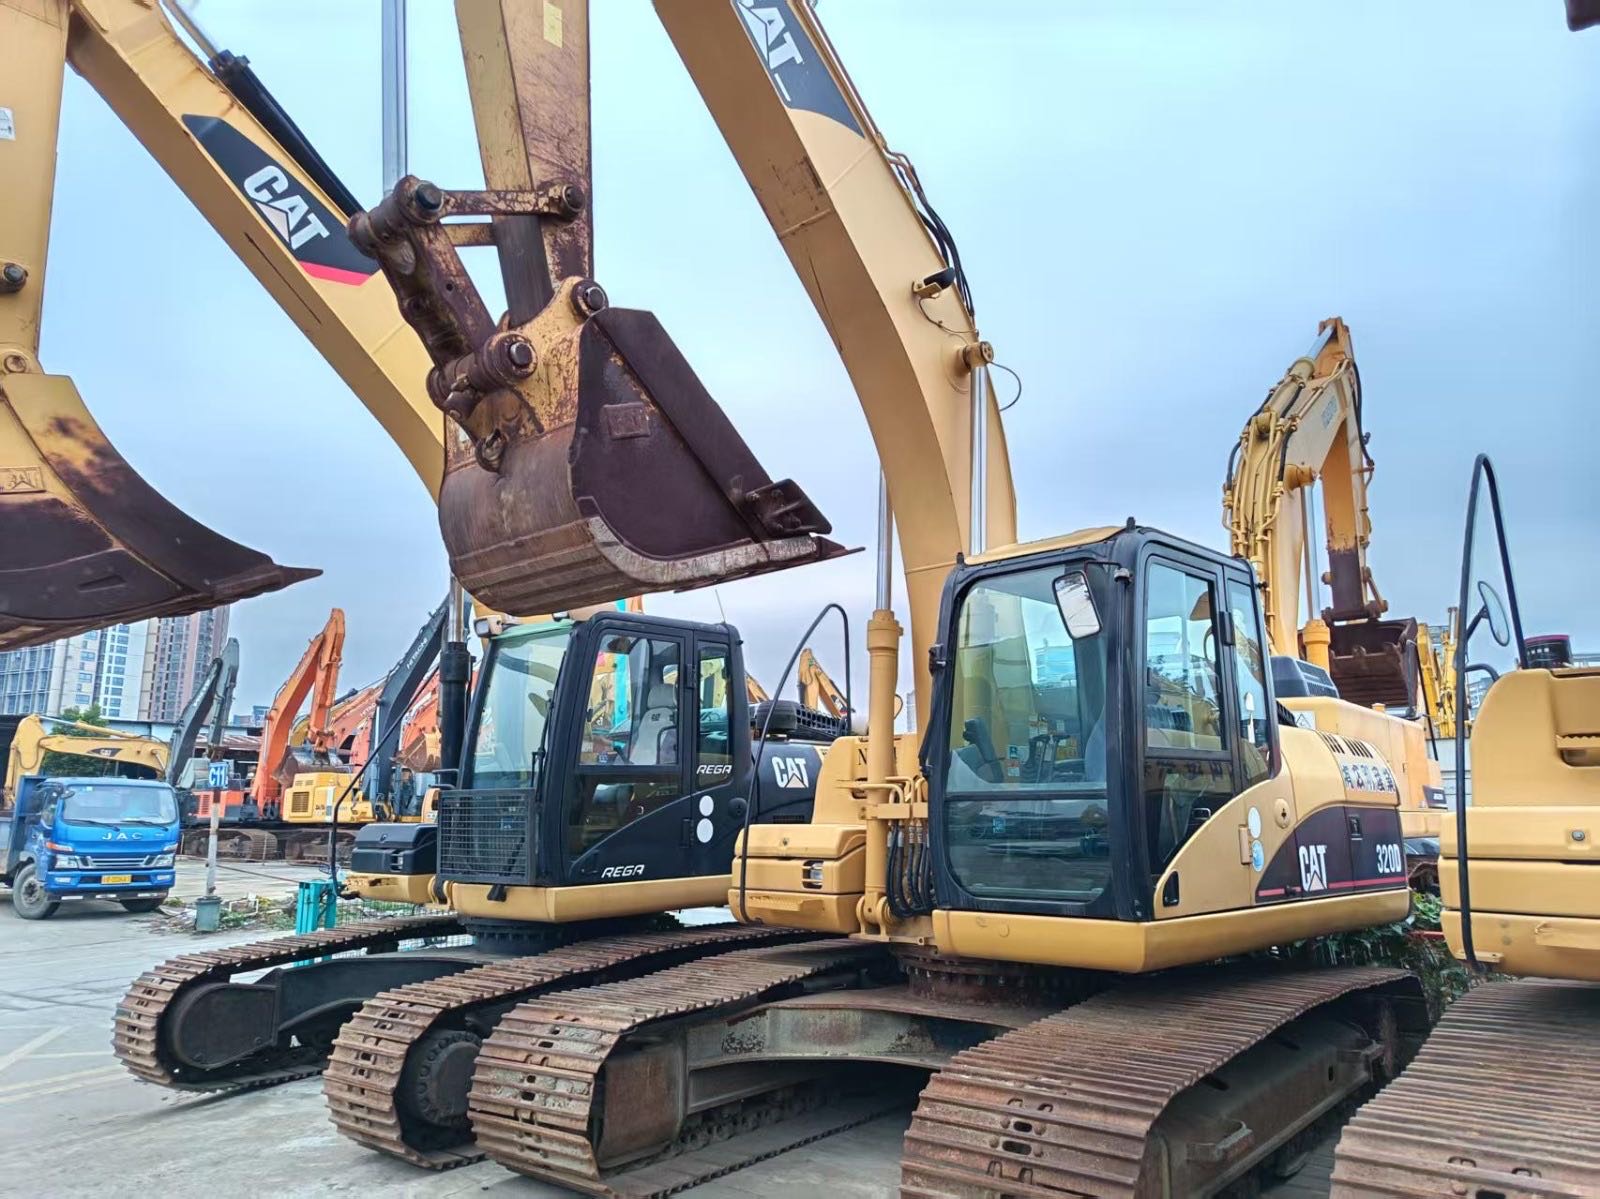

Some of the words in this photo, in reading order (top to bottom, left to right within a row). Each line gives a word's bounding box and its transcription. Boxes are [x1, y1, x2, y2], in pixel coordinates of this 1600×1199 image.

[244, 165, 331, 250] CAT
[696, 764, 732, 775] REGA
[772, 756, 810, 789] CAT
[102, 832, 143, 840] JAC
[601, 864, 645, 879] REGA
[1298, 844, 1328, 892] CAT
[1376, 843, 1403, 874] 320D
